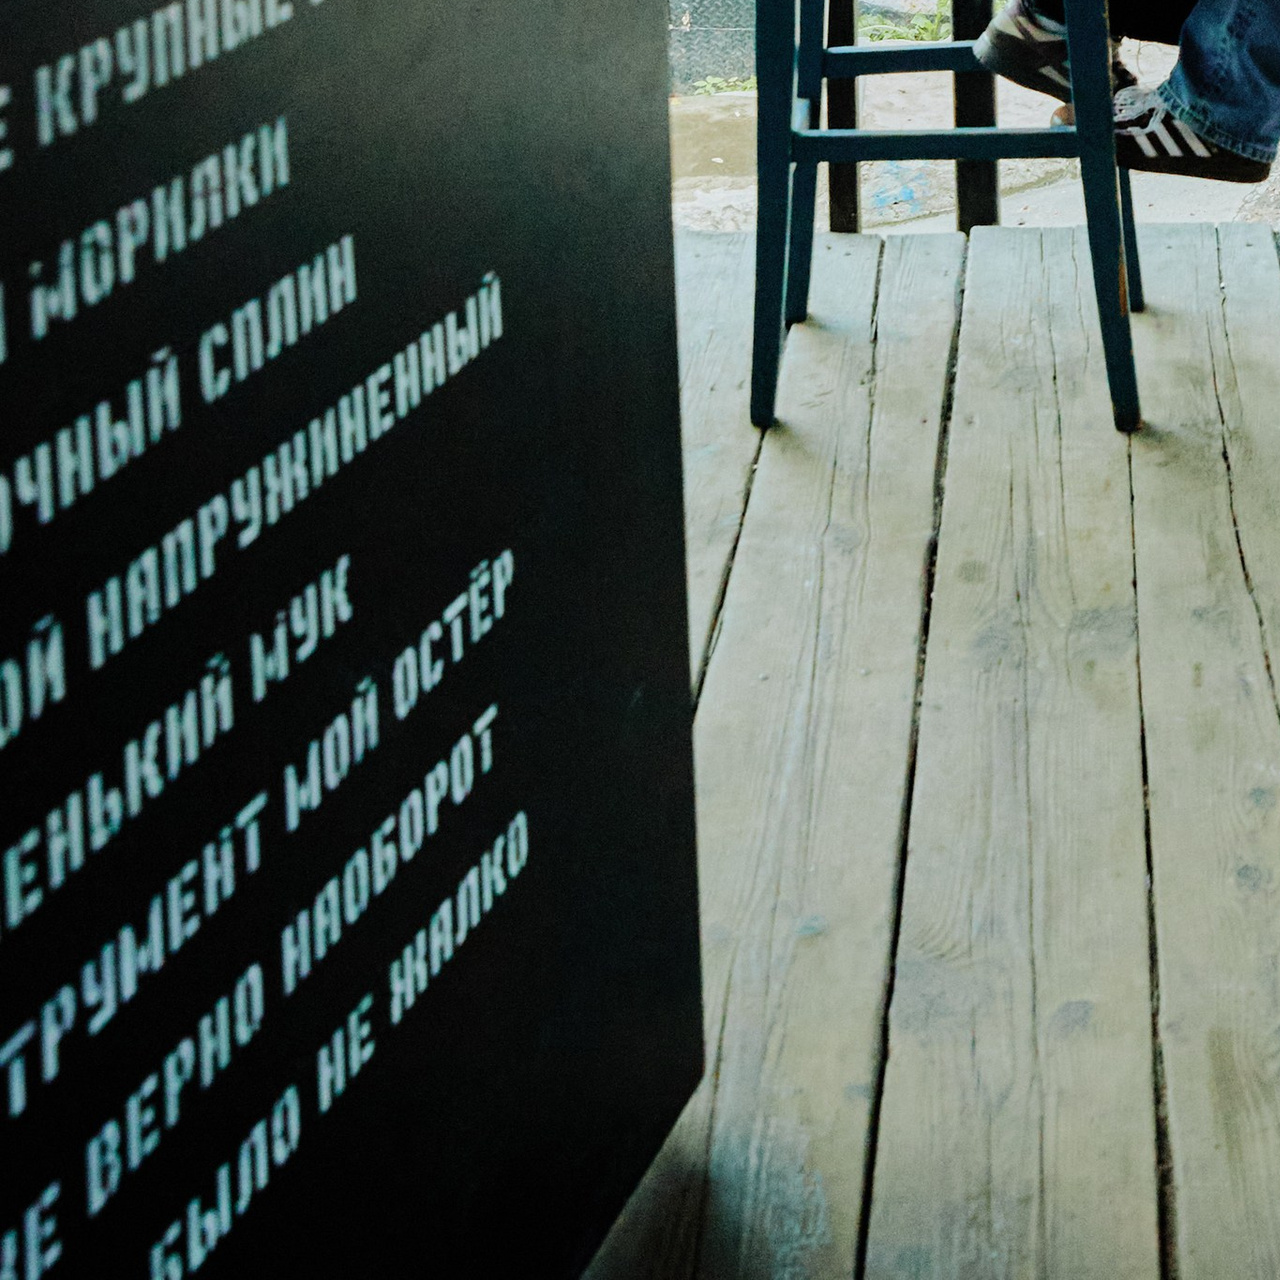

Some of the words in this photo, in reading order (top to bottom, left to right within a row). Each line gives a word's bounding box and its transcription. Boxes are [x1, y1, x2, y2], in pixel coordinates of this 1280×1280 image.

[28, 114, 290, 339] МОРИЛКИ
[199, 234, 358, 403] СПЛИН
[87, 271, 503, 670] НАПРУЖИНЕННЫЙ
[250, 553, 353, 703] МУК
[284, 676, 378, 831] МОЙ
[392, 547, 514, 721] ОСТЁР
[86, 962, 265, 1216] ВЕРНО
[280, 704, 498, 996] НАОБОРОТ
[316, 993, 376, 1113] НЕ
[388, 810, 530, 1025] ЖАЛКО
